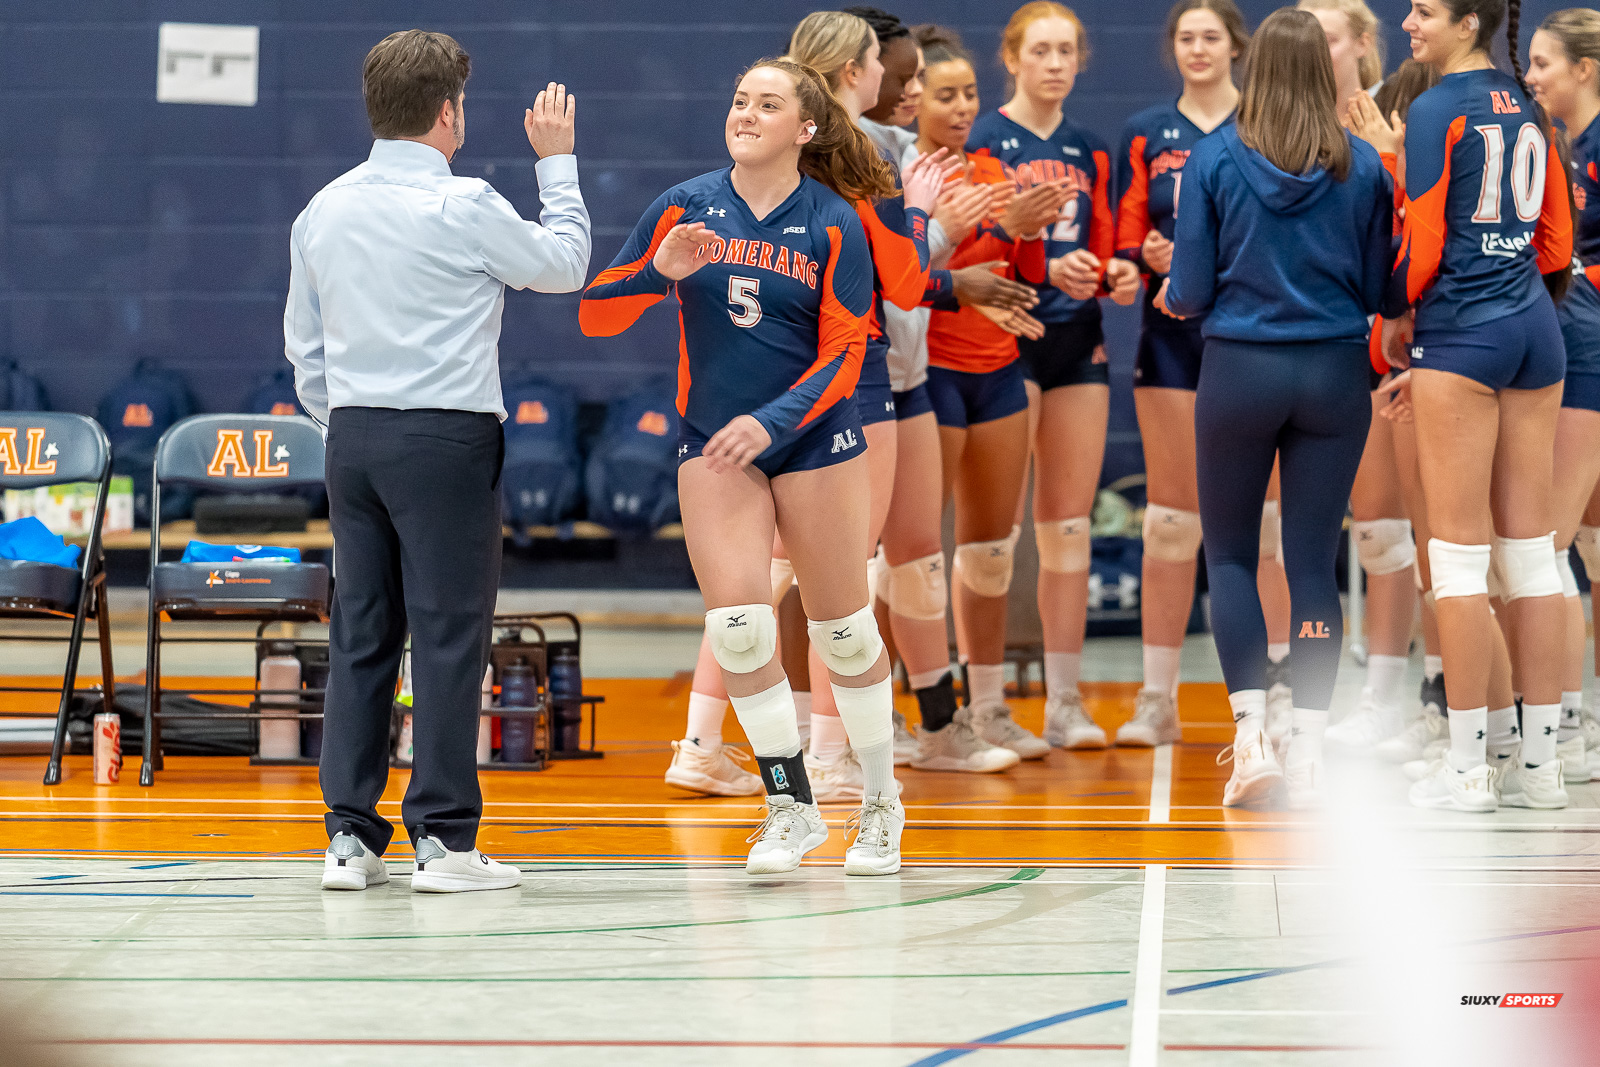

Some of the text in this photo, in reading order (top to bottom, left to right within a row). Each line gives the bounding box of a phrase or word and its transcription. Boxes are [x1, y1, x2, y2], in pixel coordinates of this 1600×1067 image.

[1490, 90, 1522, 114] AL
[1471, 121, 1547, 223] 10
[727, 275, 763, 328] 5
[207, 430, 289, 477] AL
[831, 428, 858, 453] AL
[1298, 621, 1330, 638] AL
